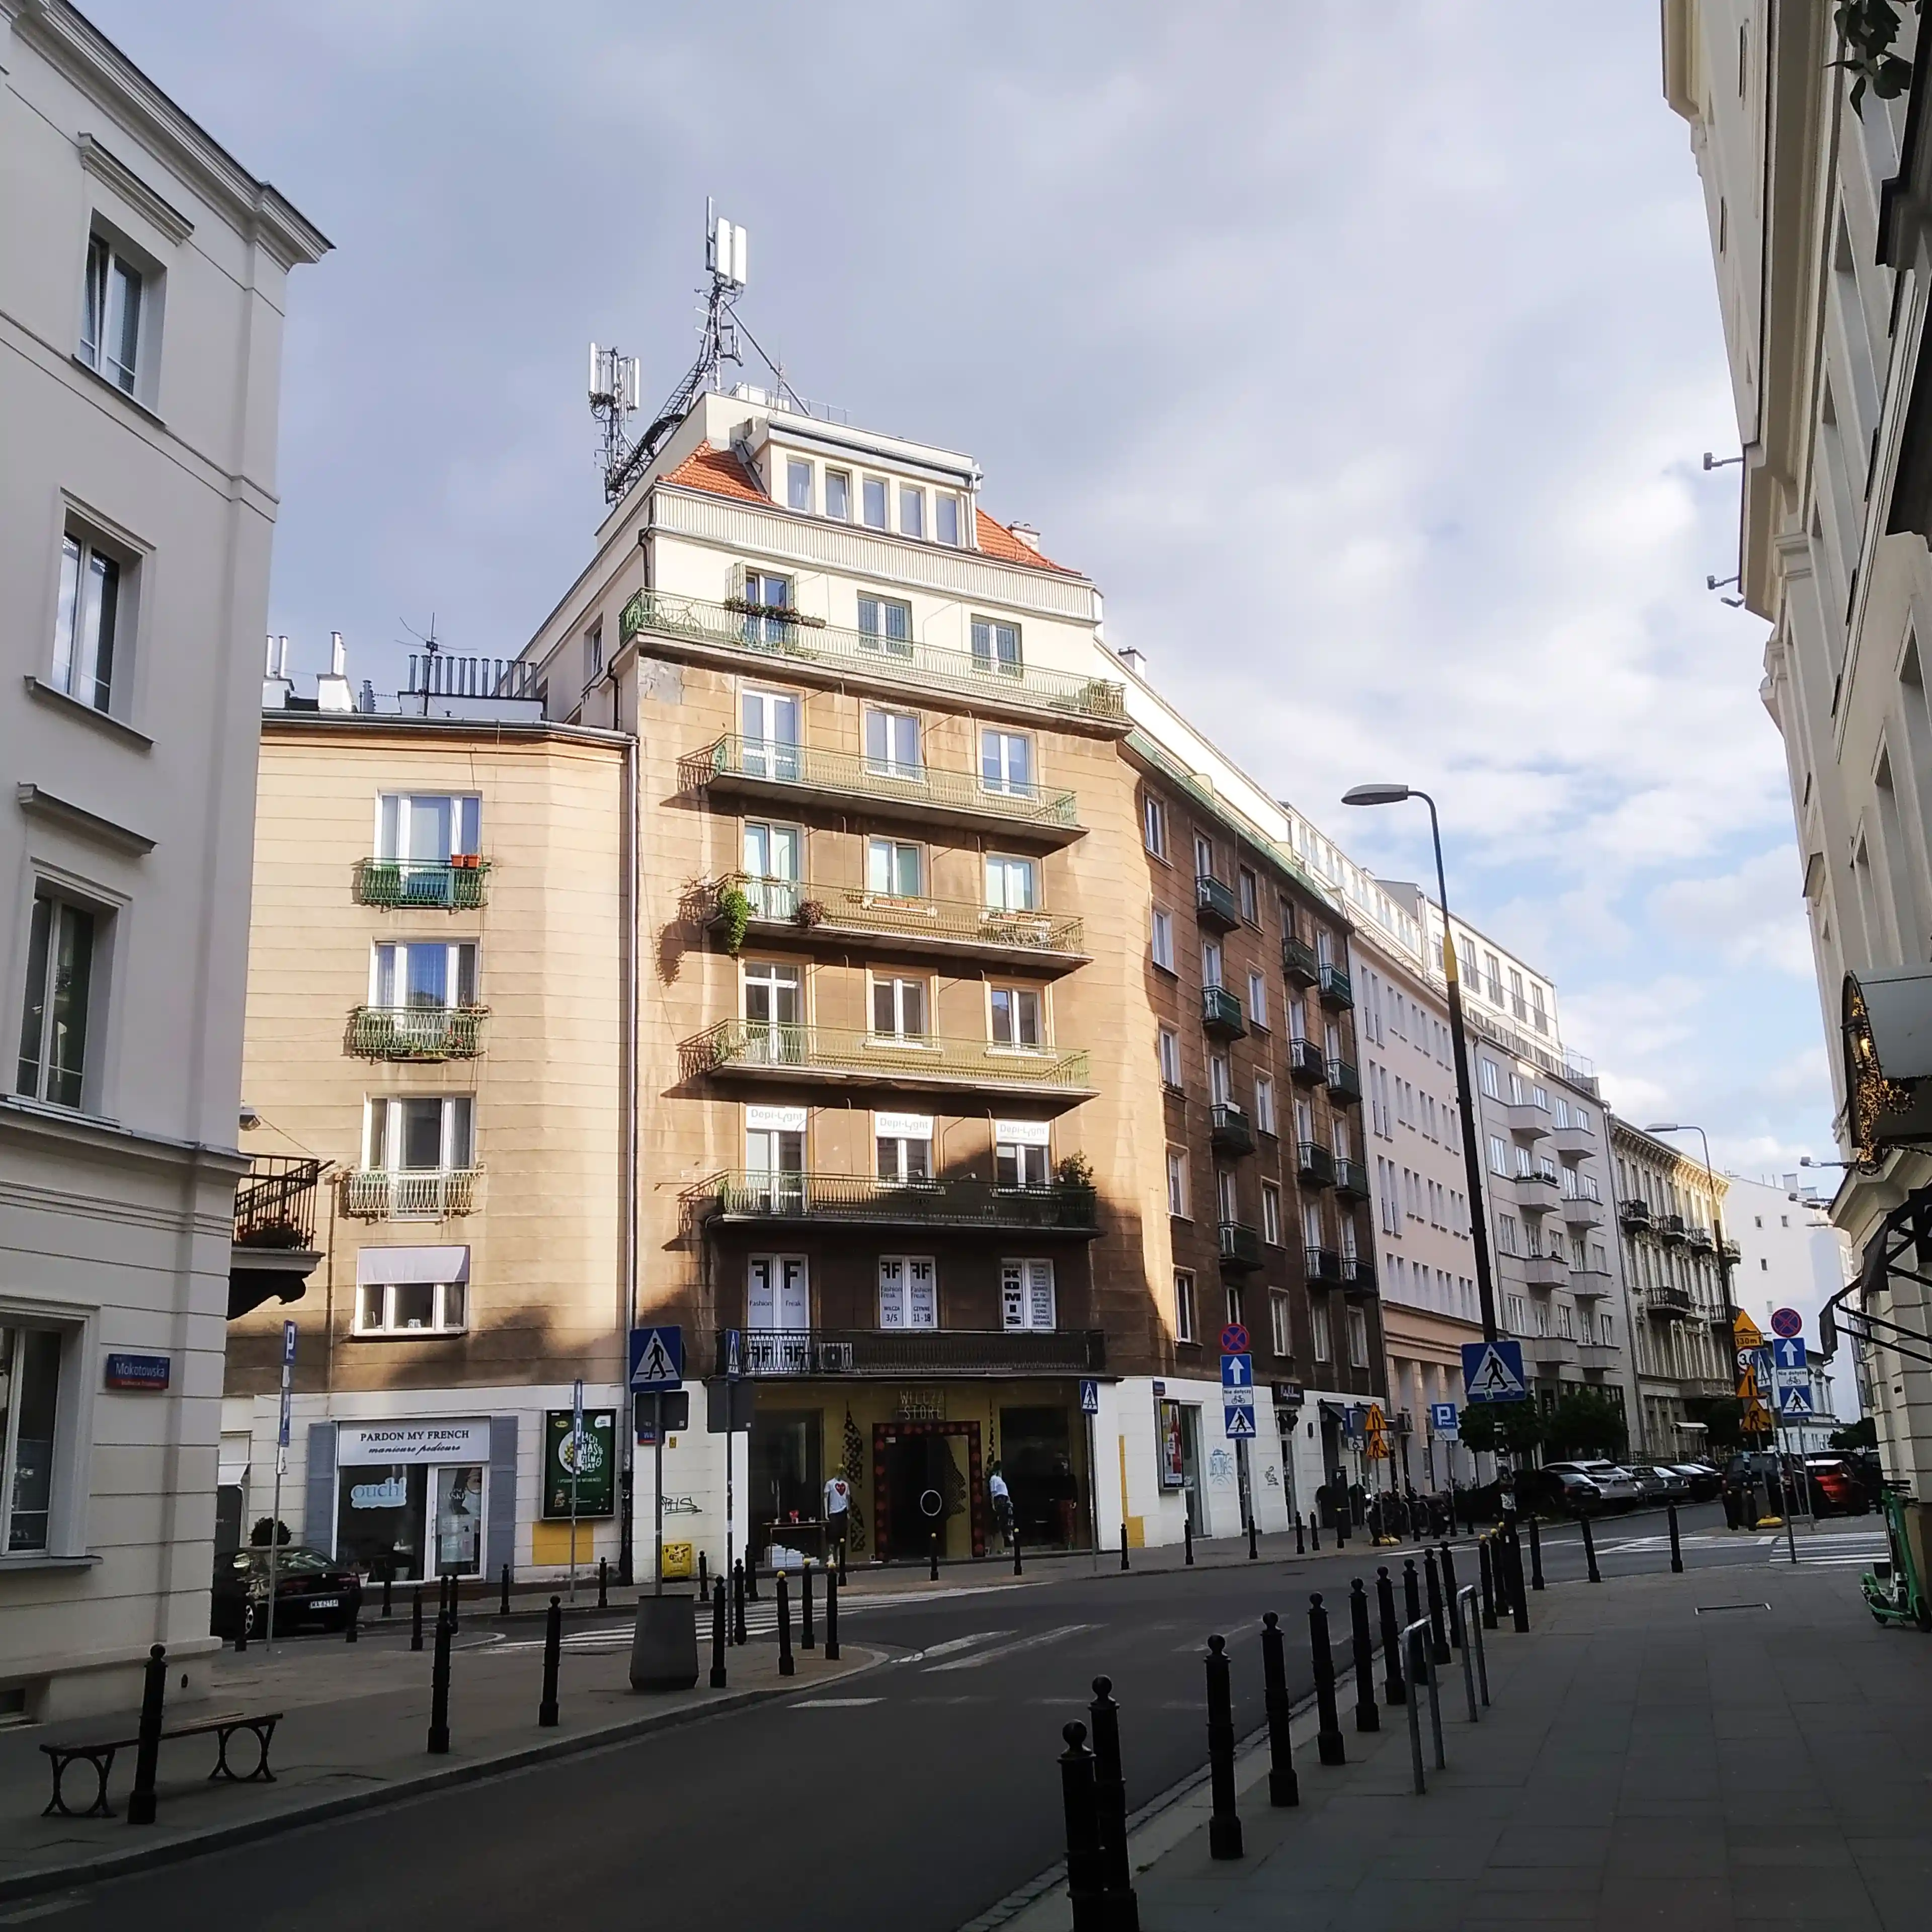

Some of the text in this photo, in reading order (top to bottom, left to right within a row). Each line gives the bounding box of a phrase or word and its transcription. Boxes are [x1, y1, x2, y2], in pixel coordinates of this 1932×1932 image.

[116, 1362, 165, 1378] Mokotowska
[1436, 1406, 1451, 1425] P
[361, 1430, 469, 1441] PARDON MY FRENCH
[369, 1442, 460, 1456] manicure pedicure
